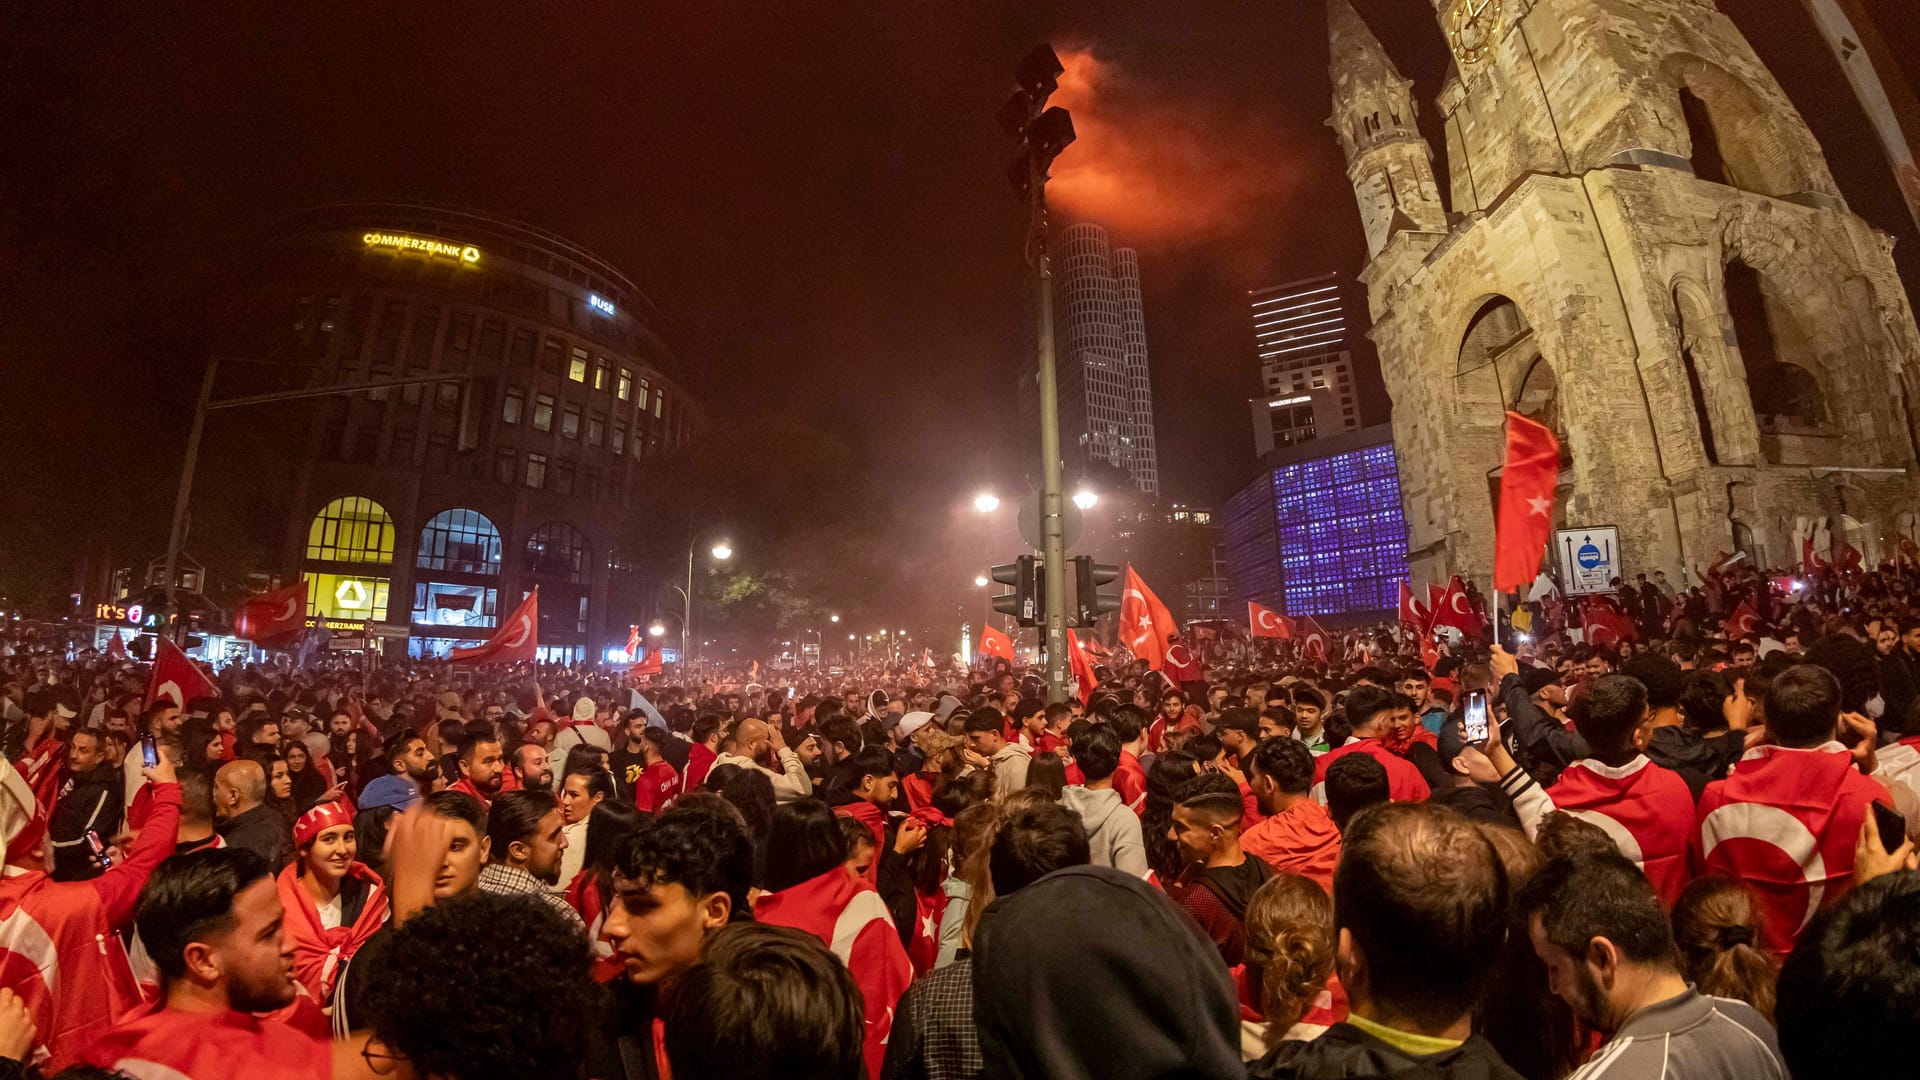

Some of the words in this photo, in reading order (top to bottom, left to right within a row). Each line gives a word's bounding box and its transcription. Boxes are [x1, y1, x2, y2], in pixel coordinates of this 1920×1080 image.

[364, 234, 460, 256] COMMERZBANK
[591, 295, 614, 315] BUSE
[96, 603, 126, 620] it's
[305, 620, 364, 631] COERZBANK
